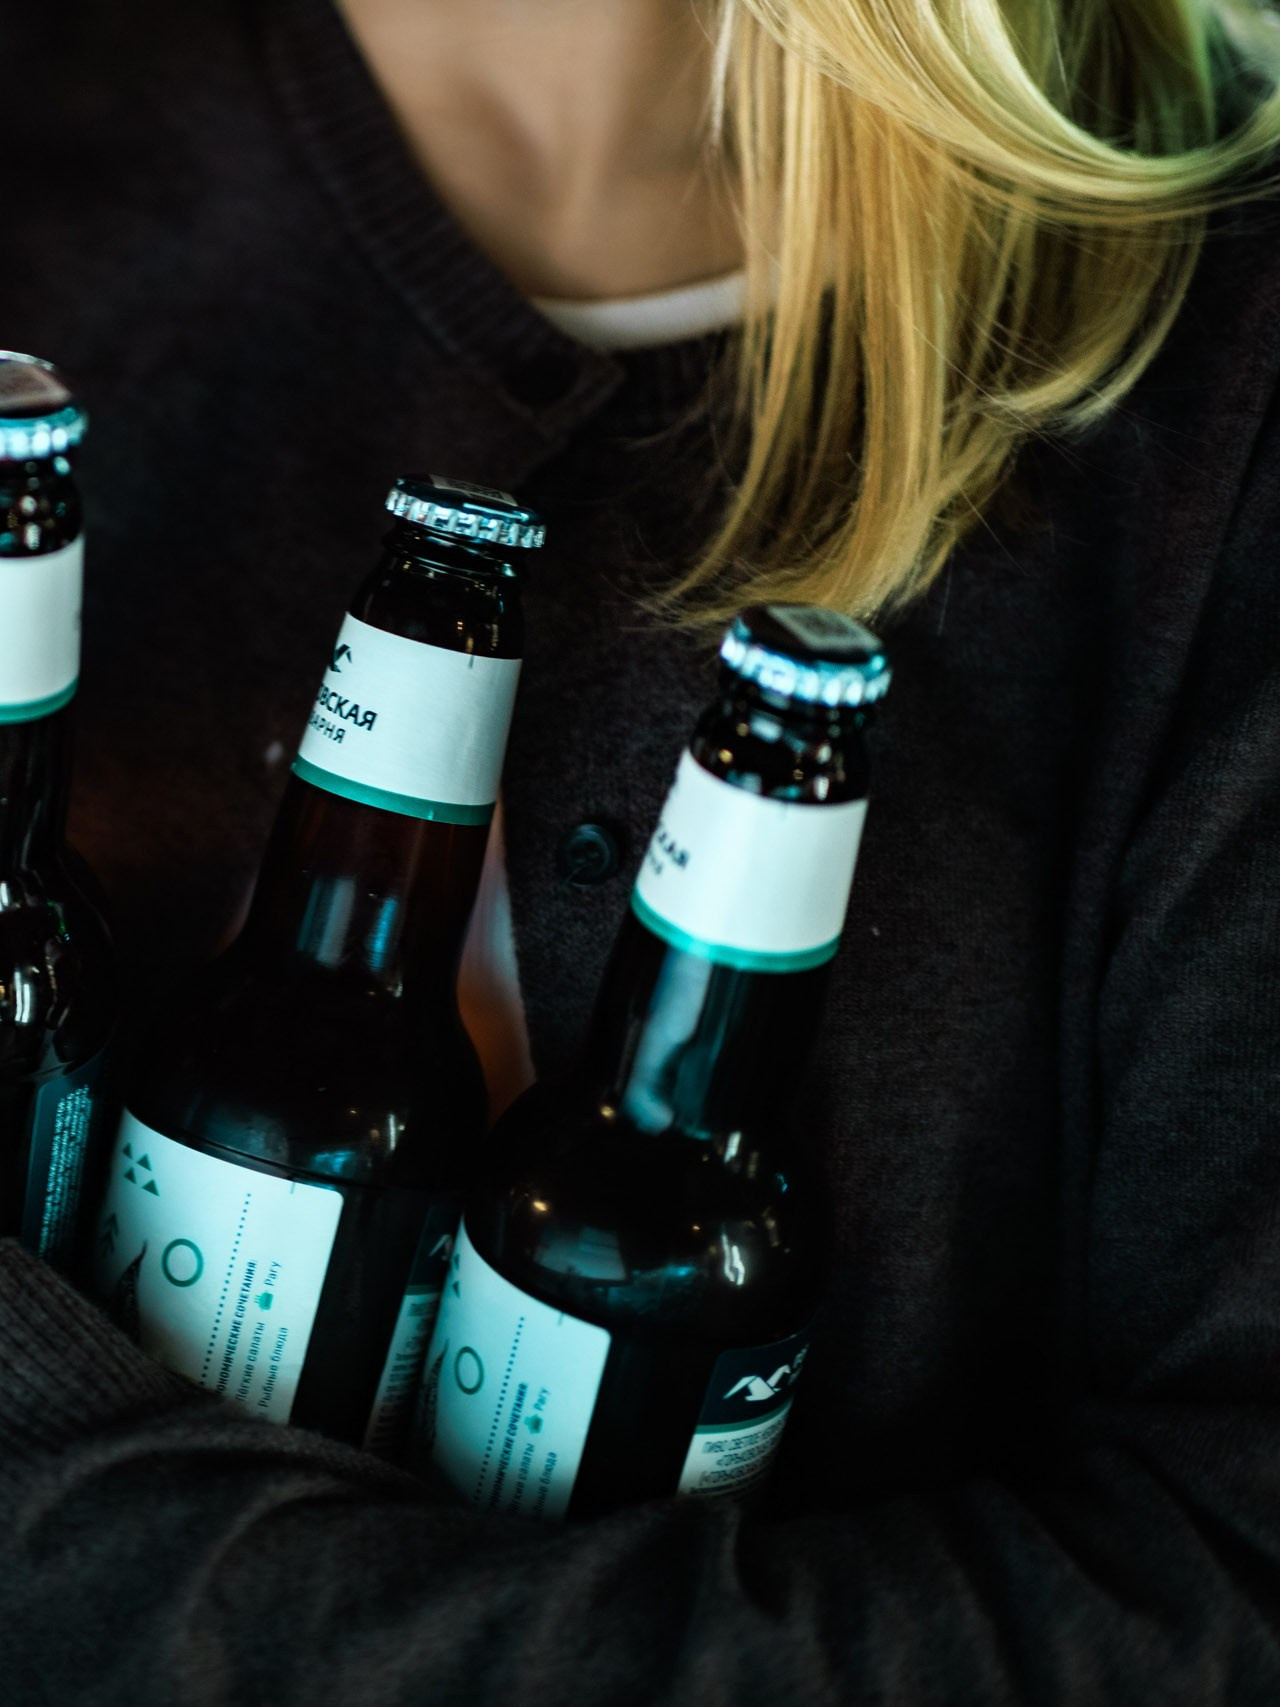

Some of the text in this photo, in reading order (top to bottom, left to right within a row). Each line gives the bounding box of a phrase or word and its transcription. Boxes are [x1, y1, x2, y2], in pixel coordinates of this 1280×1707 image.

[263, 1260, 283, 1287] Рагу
[247, 1321, 266, 1363] салаты
[257, 1327, 289, 1408] Рыбные блюда
